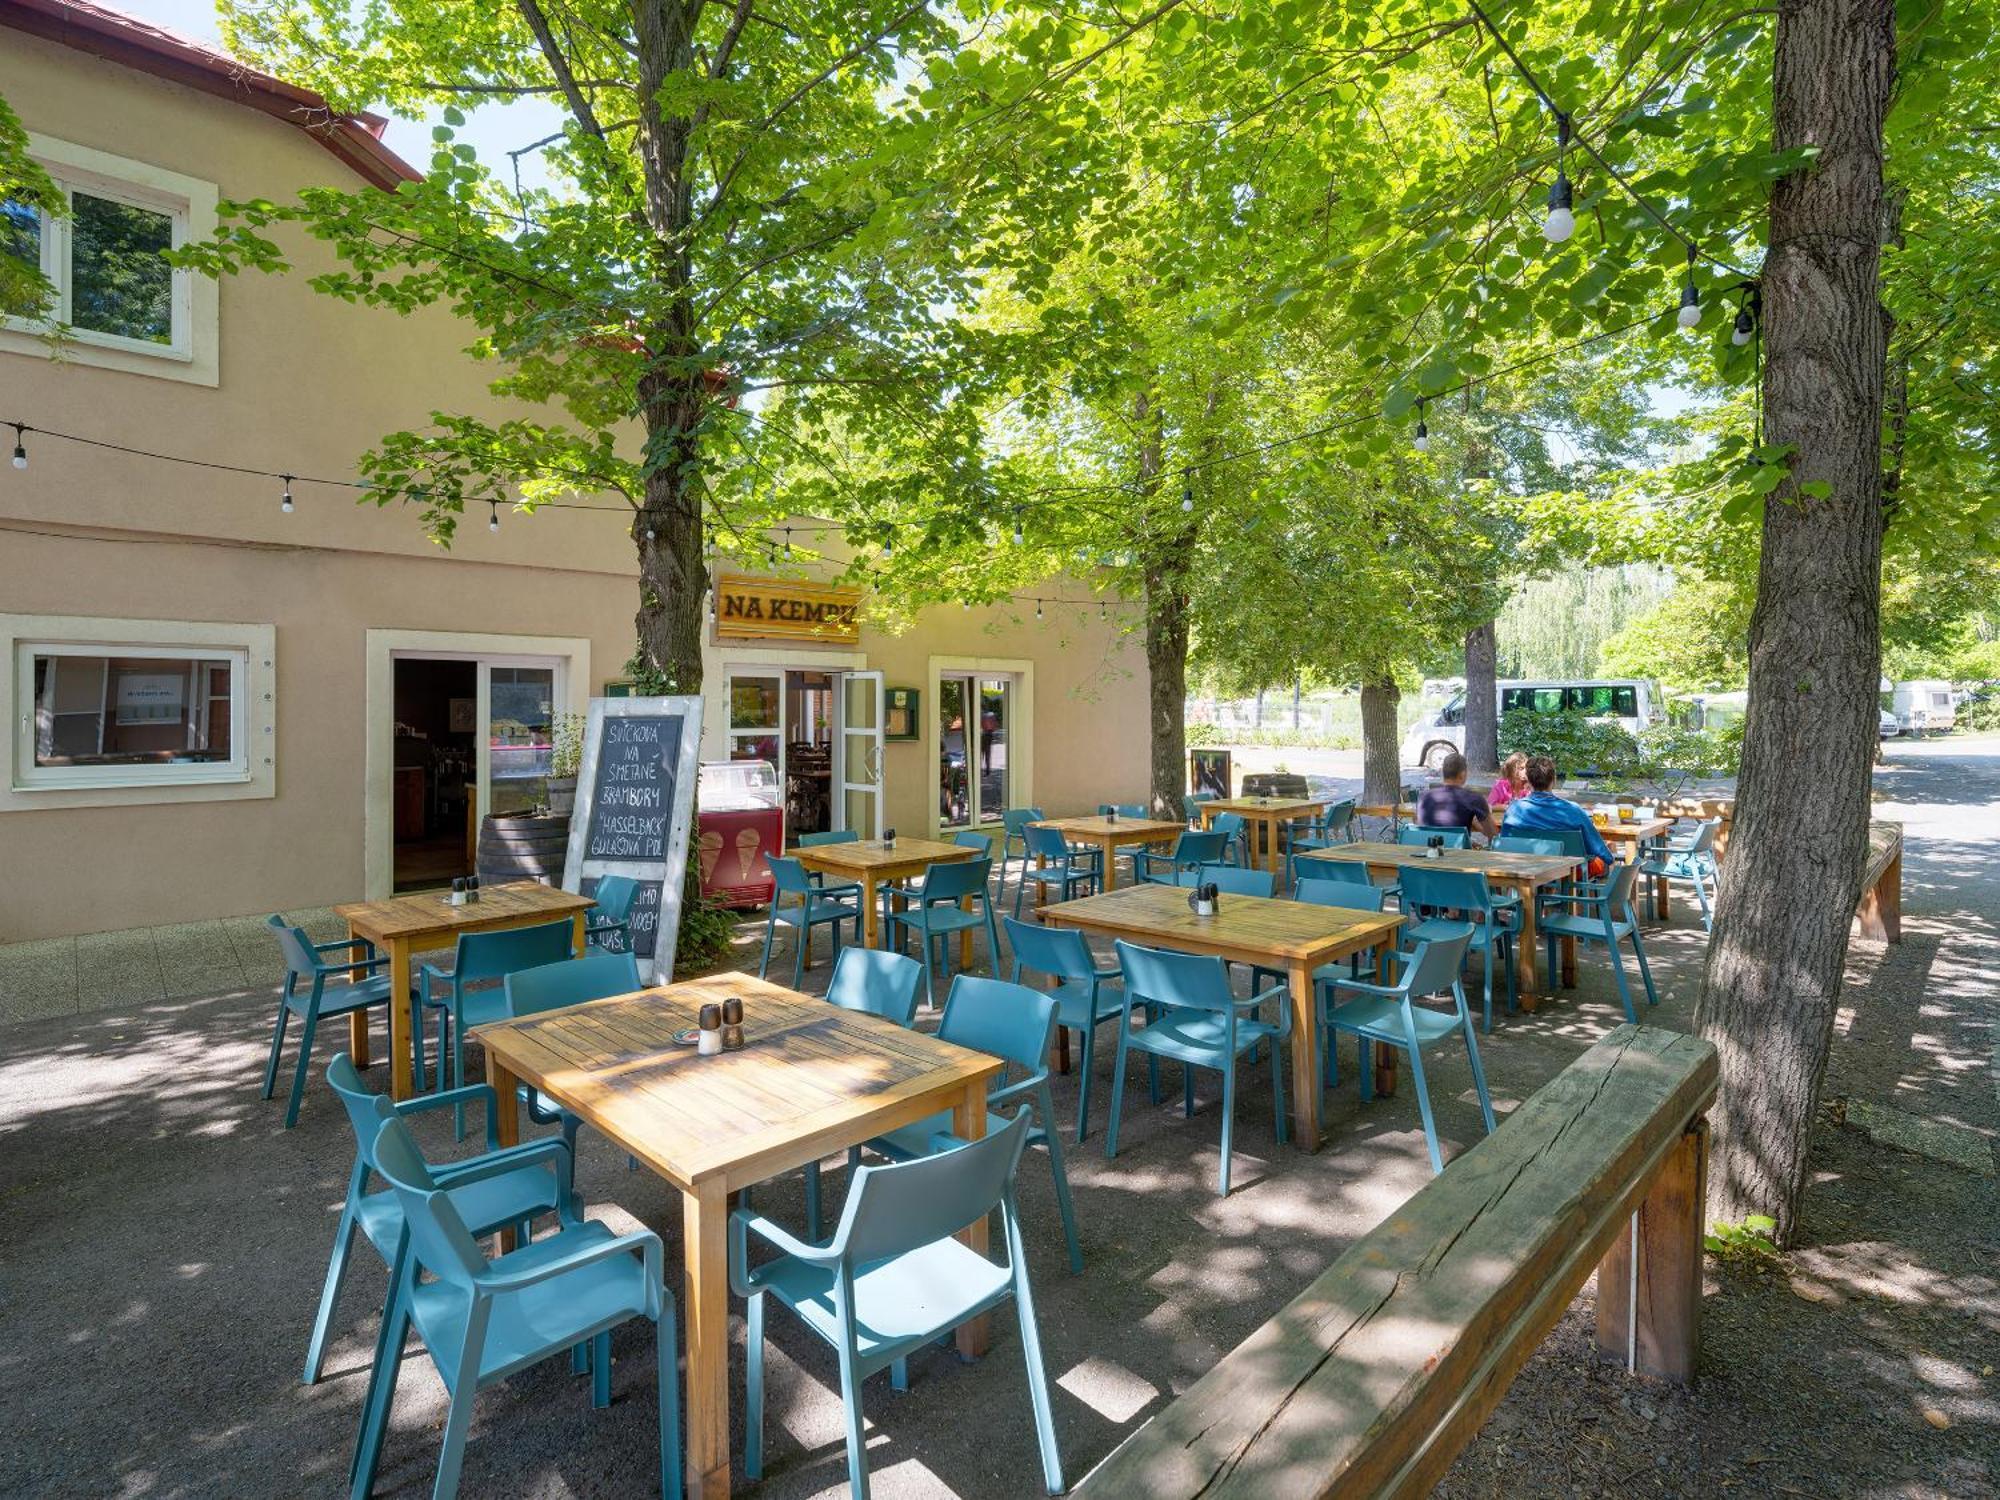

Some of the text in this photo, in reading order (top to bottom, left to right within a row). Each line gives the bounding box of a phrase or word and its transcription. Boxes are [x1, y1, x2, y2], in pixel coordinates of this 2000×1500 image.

[725, 595, 764, 619] NA
[623, 746, 640, 761] NA
[600, 785, 660, 808] BRAMBORY
[633, 889, 657, 905] IMO
